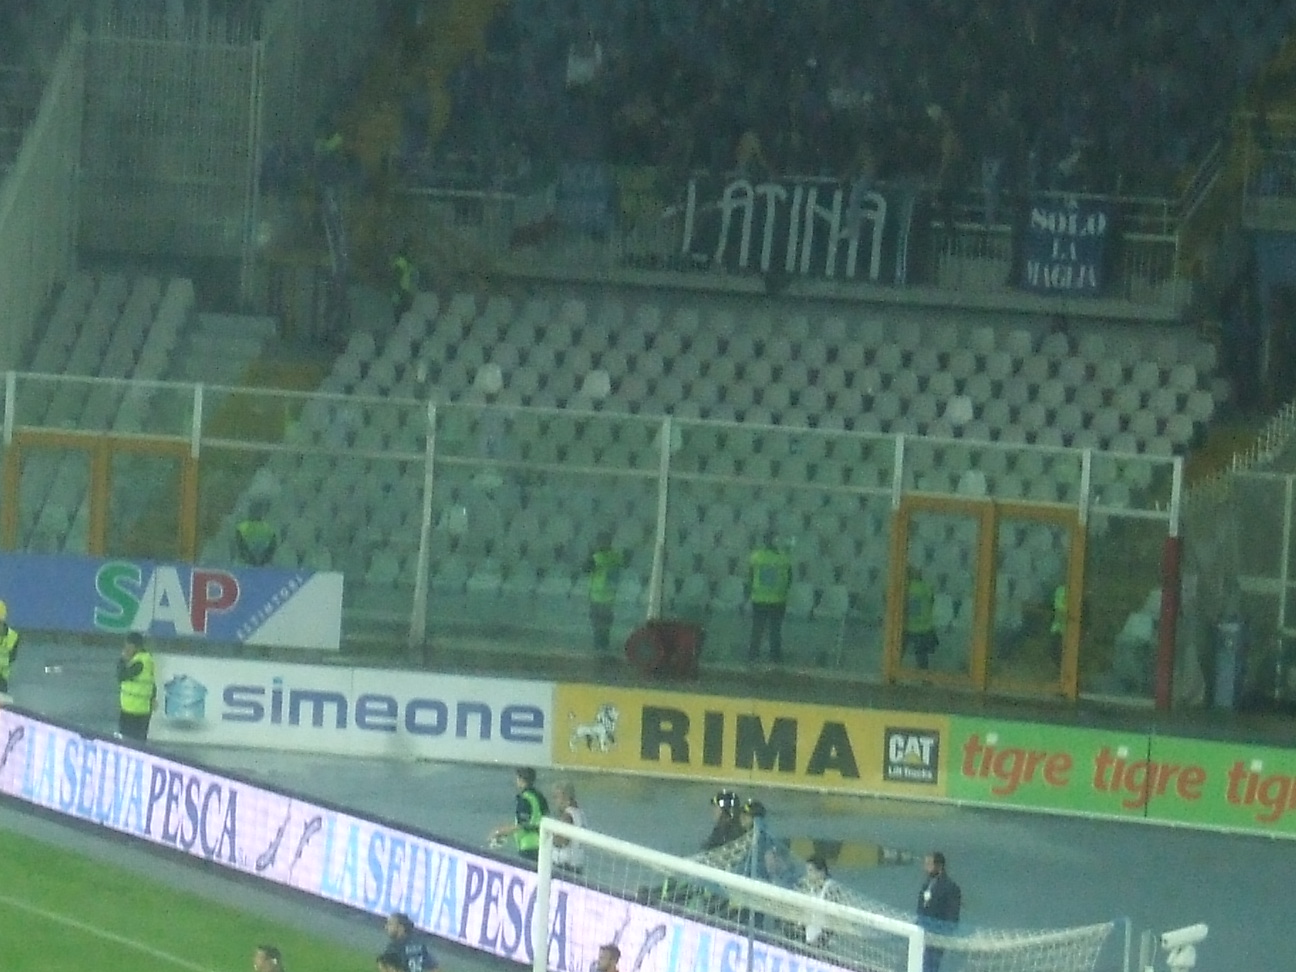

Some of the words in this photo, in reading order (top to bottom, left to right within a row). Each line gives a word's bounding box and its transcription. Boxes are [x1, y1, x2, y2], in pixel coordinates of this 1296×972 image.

[93, 560, 241, 637] SAP
[221, 676, 545, 744] simeone
[640, 704, 861, 779] RIMA
[888, 734, 935, 765] CAT
[961, 731, 1074, 798] tigre
[1093, 744, 1208, 812] tigre
